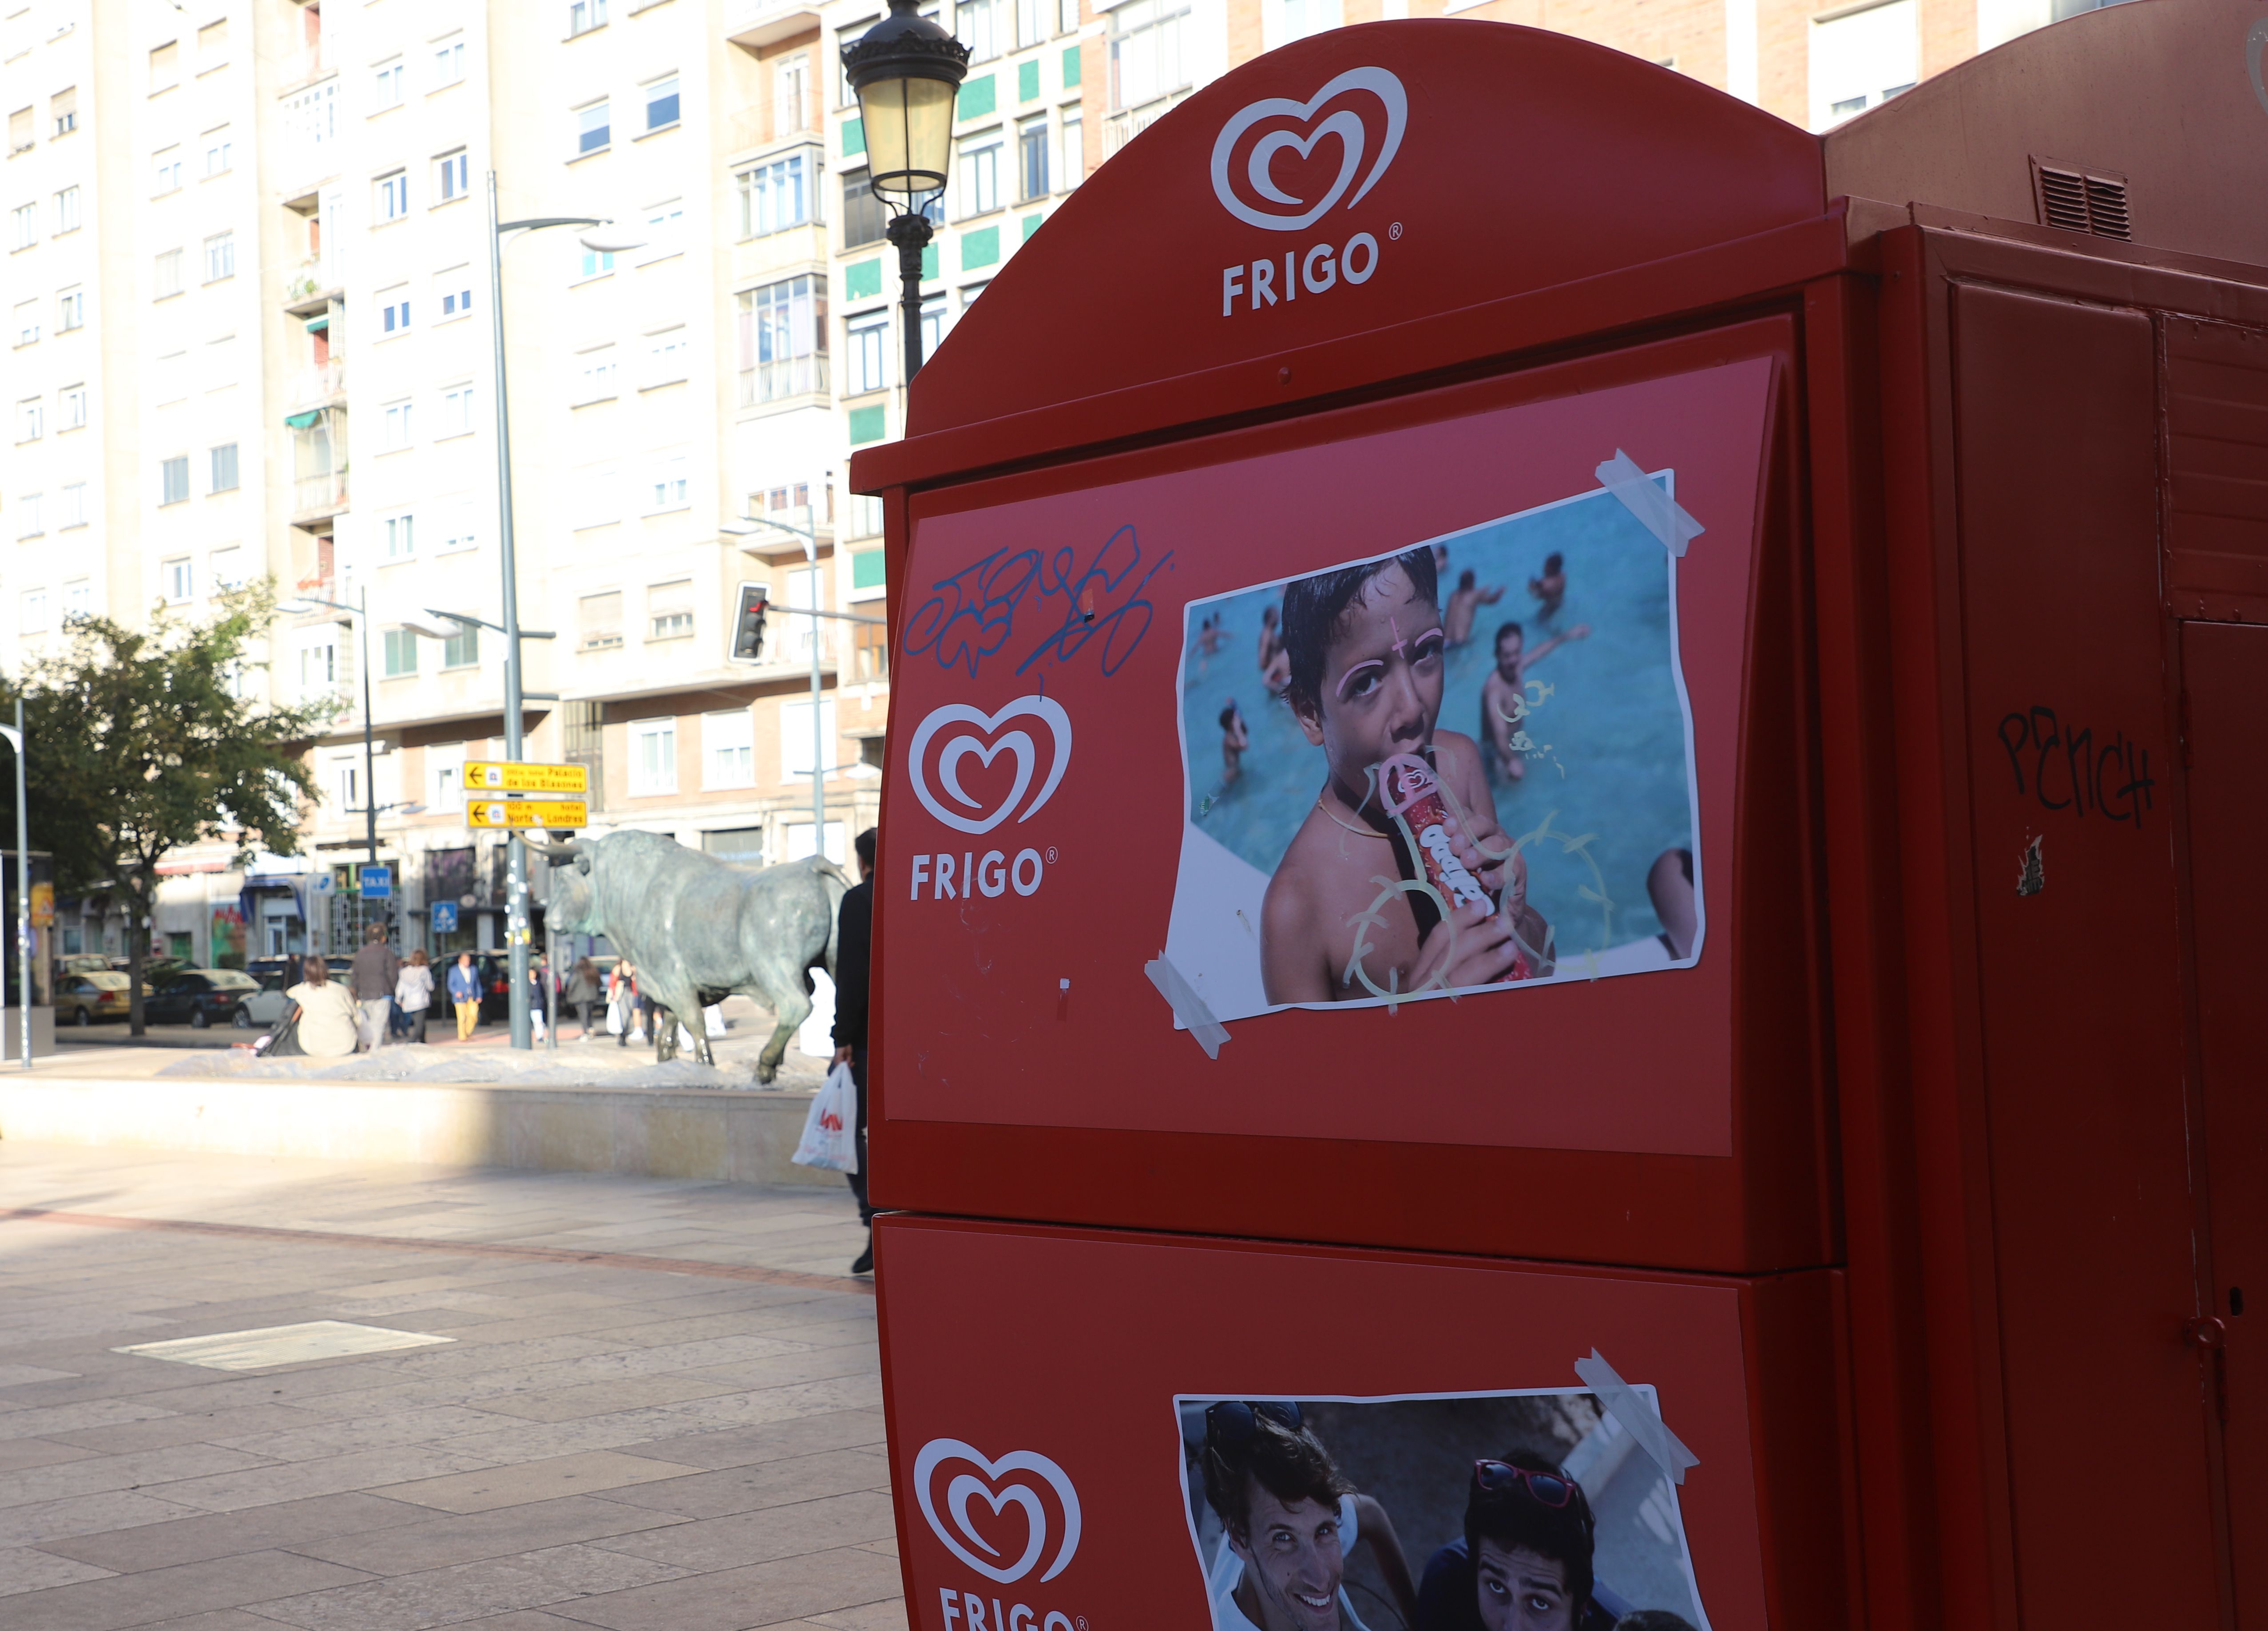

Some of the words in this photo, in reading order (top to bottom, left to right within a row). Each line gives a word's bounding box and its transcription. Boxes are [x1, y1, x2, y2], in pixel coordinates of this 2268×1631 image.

[1222, 232, 1379, 317] FRIGO
[548, 768, 583, 777] Palacio
[540, 779, 583, 788] Blasones
[547, 814, 583, 823] Londres
[910, 847, 1043, 901] FRIGO
[364, 876, 389, 887] TAXI
